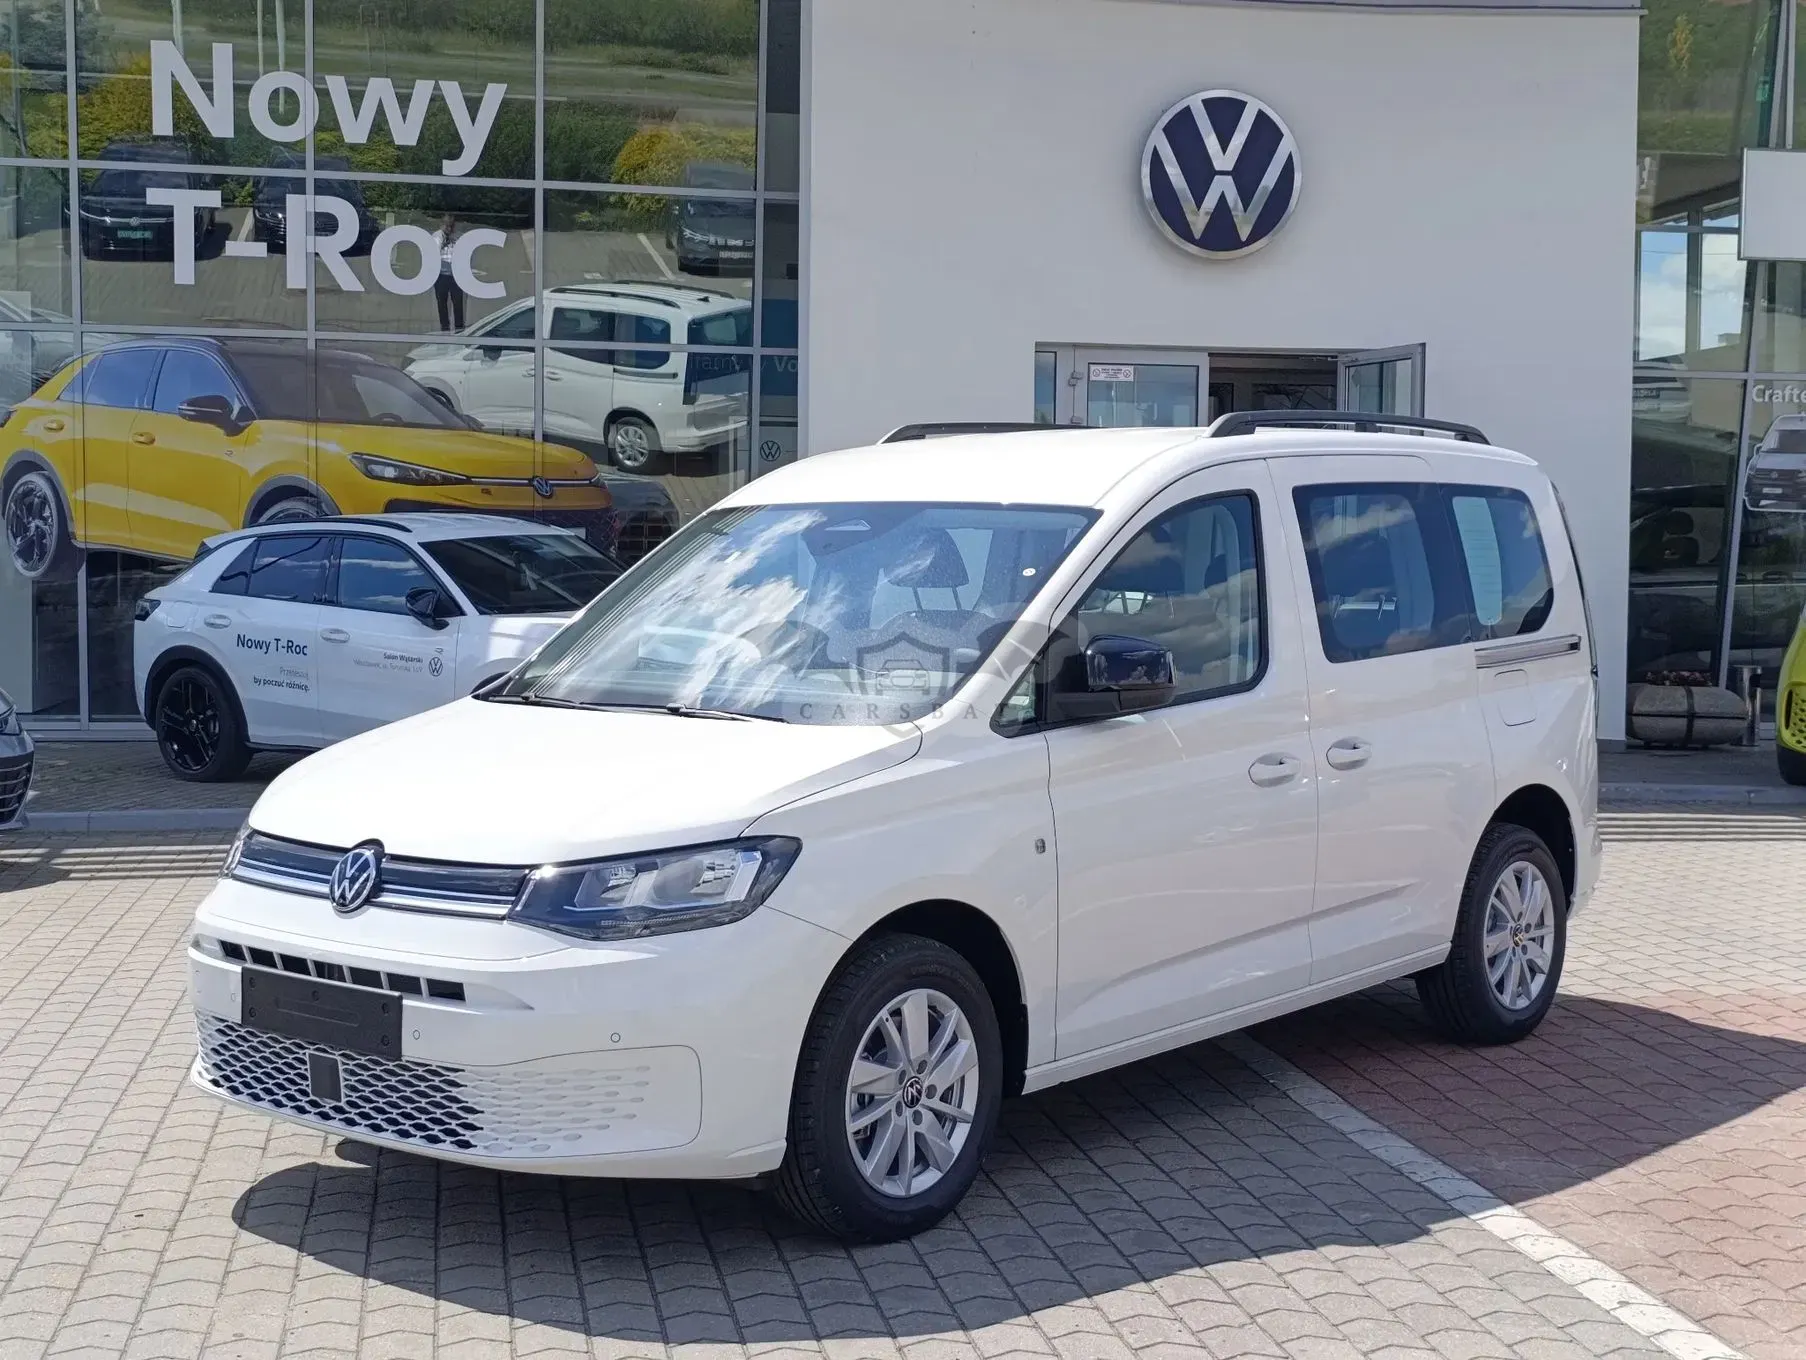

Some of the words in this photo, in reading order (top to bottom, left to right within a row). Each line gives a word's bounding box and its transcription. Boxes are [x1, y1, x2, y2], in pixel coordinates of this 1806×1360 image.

[150, 39, 507, 177] Nowy
[146, 187, 507, 299] T-Roc
[236, 633, 271, 655] Nowy
[274, 638, 308, 656] T-Roc
[253, 674, 262, 686] by
